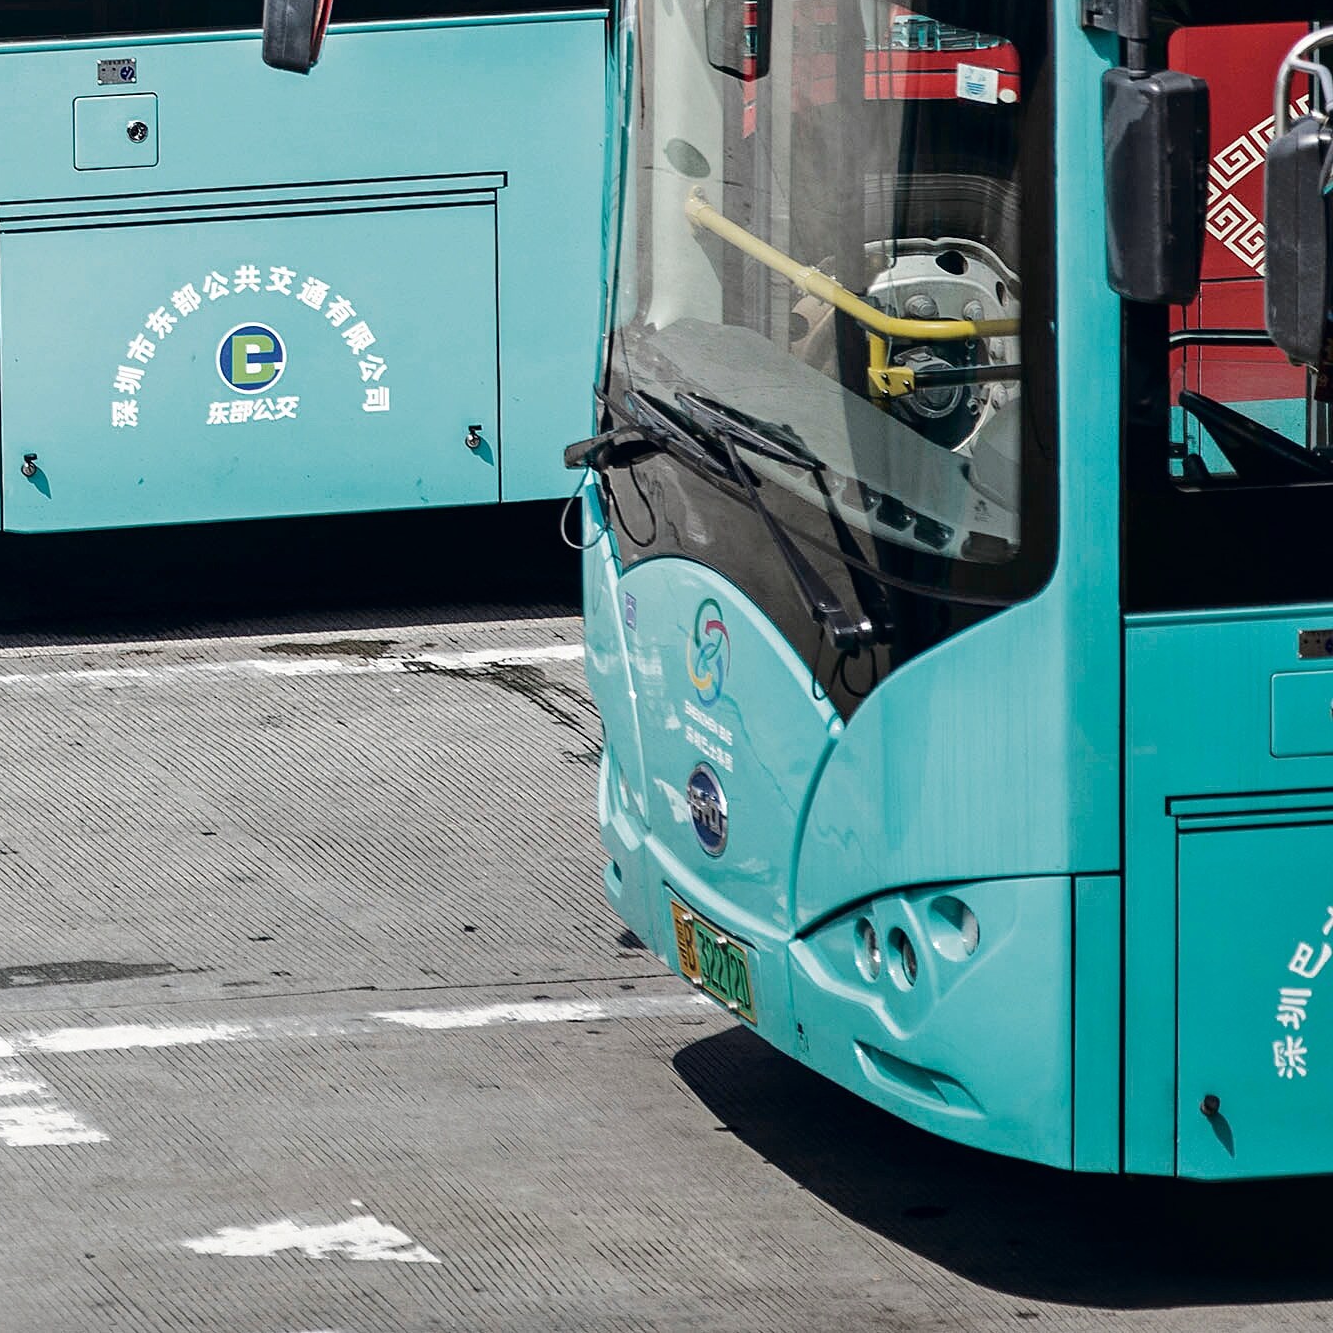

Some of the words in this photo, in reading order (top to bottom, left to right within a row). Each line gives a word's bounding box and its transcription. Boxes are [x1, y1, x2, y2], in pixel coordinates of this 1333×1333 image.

[111, 264, 390, 428] 深圳市东部公共交通有限公司
[206, 396, 300, 425] 东部公交
